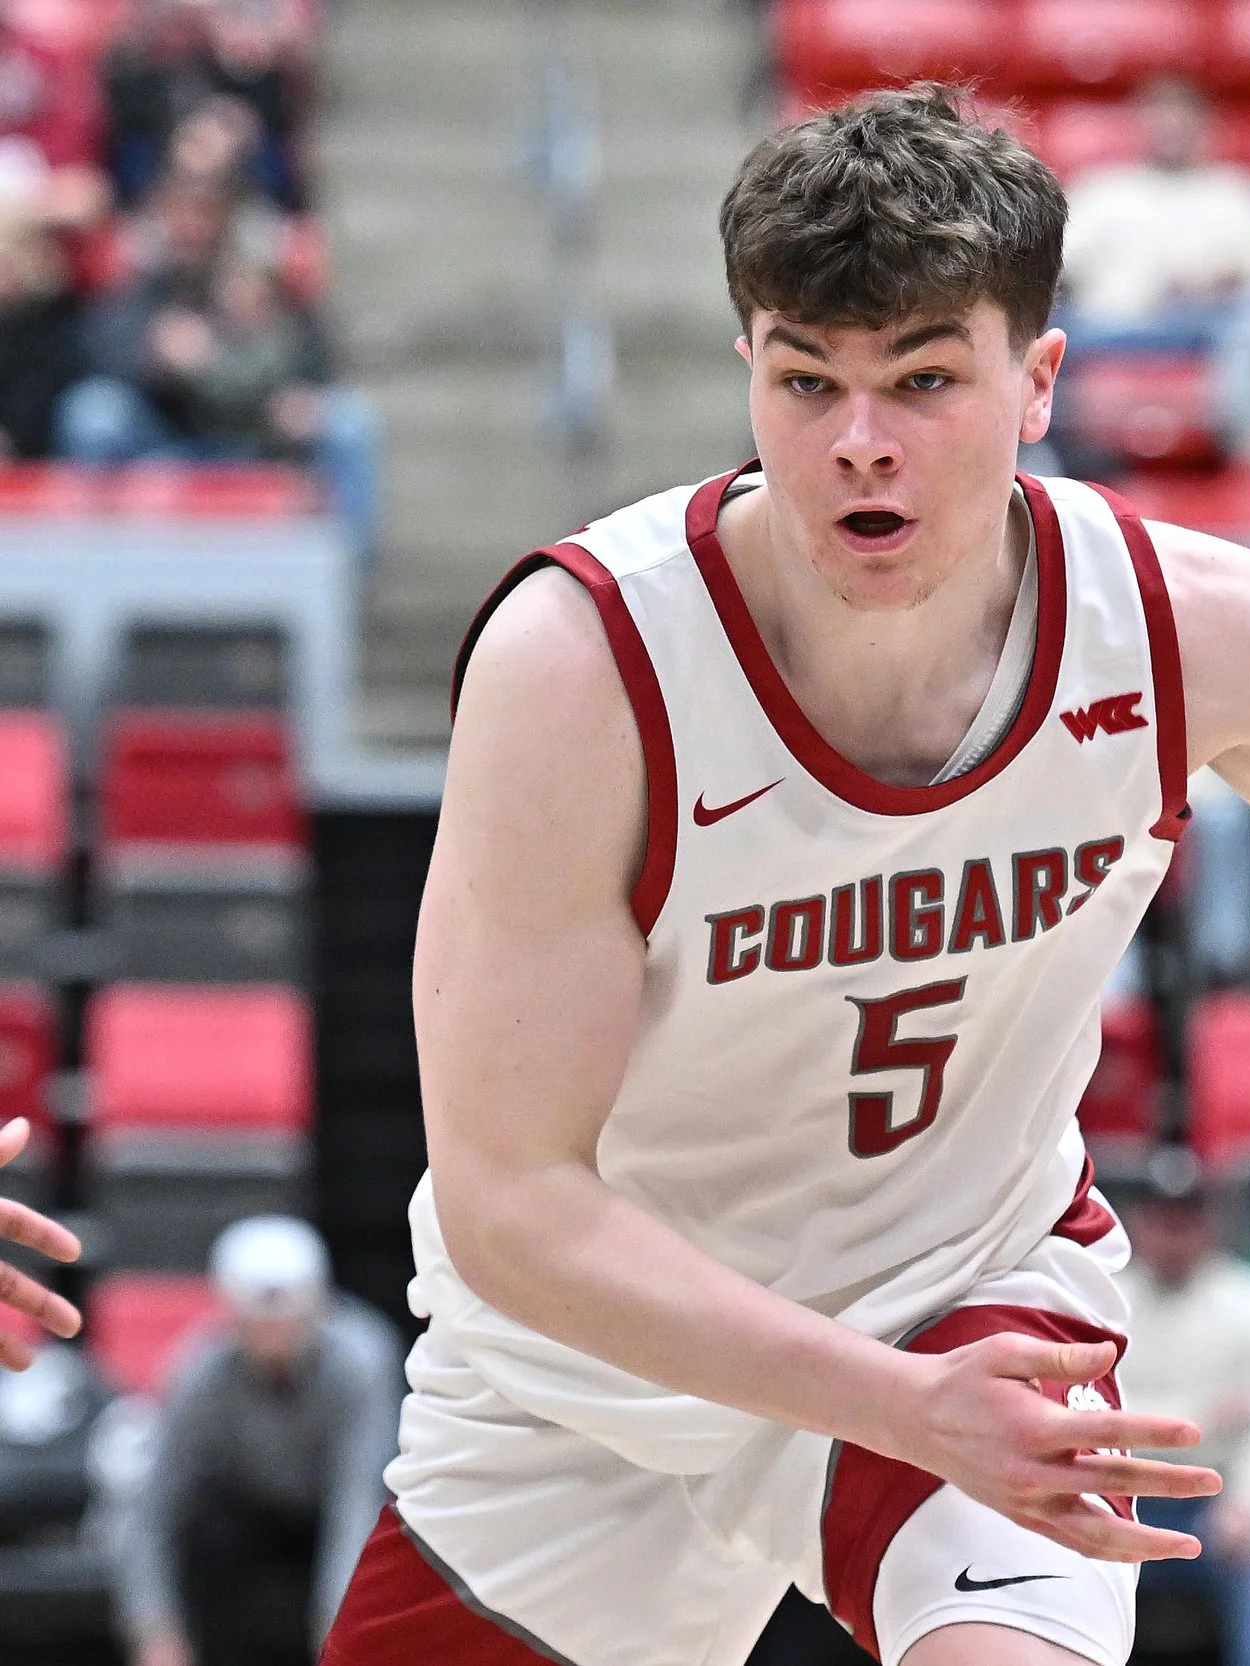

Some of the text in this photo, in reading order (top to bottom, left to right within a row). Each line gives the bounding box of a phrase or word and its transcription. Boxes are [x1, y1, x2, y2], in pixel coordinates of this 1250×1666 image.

[1060, 692, 1149, 744] WCC
[705, 835, 1125, 985] COUGARS
[844, 975, 969, 1159] 5
